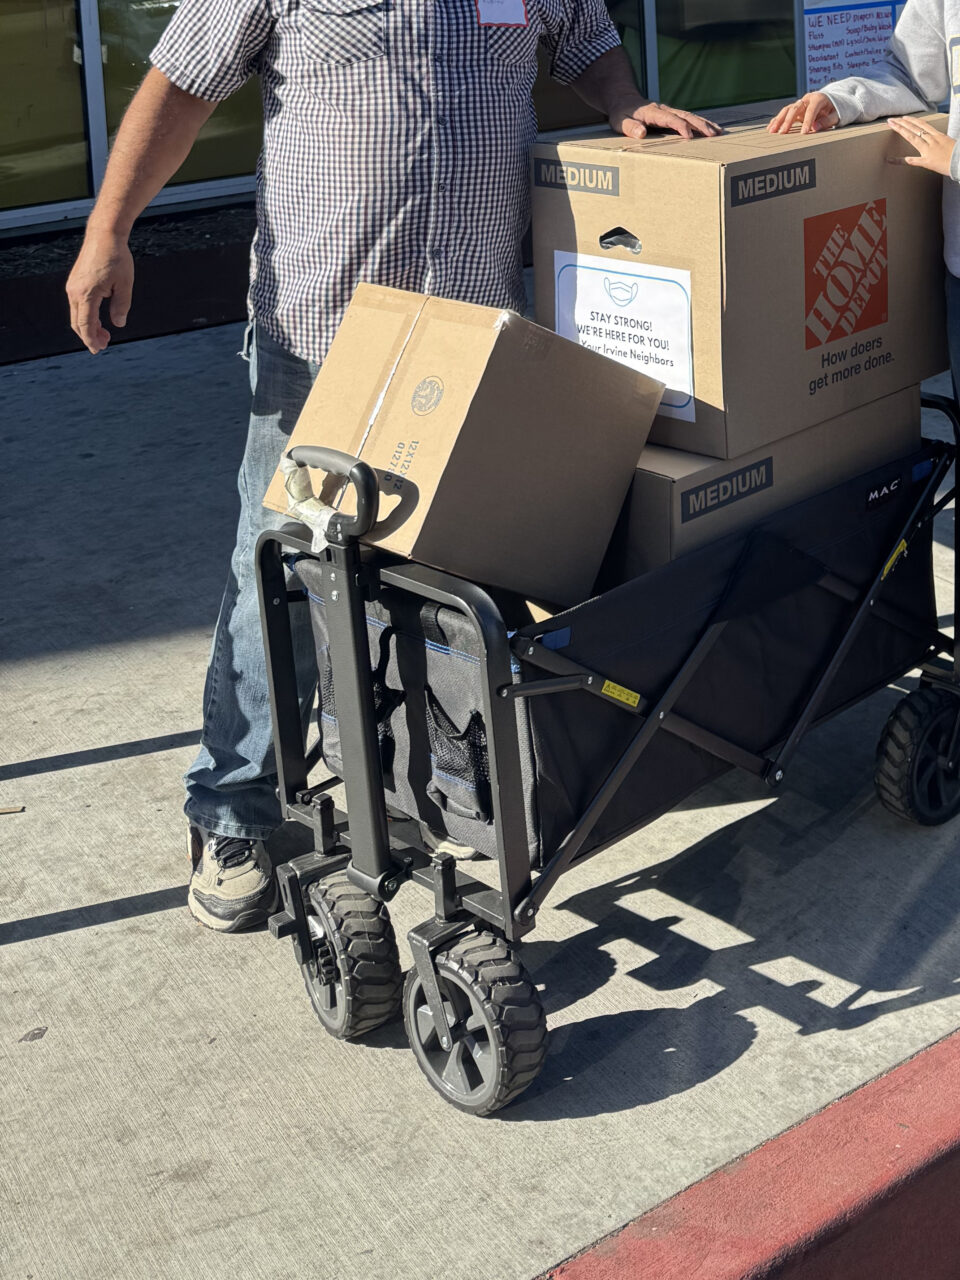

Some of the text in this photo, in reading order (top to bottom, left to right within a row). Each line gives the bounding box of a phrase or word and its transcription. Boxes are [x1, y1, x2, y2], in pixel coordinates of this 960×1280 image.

[808, 14, 824, 28] WE
[827, 12, 851, 26] NEED
[540, 163, 613, 191] MEDIUM
[737, 165, 811, 200] MEDIUM
[813, 223, 849, 280] THE
[804, 200, 888, 345] HOME
[838, 245, 889, 336] DEPOT
[577, 323, 670, 351] WE'RE HERE FOR YOU!
[590, 310, 653, 332] STAY STRONG!
[603, 343, 628, 358] Irvine
[629, 348, 674, 367] Neighbors
[821, 335, 883, 369] How doers
[808, 350, 895, 396] get more done.
[689, 464, 767, 515] MEDIUM
[868, 480, 898, 502] MAC
